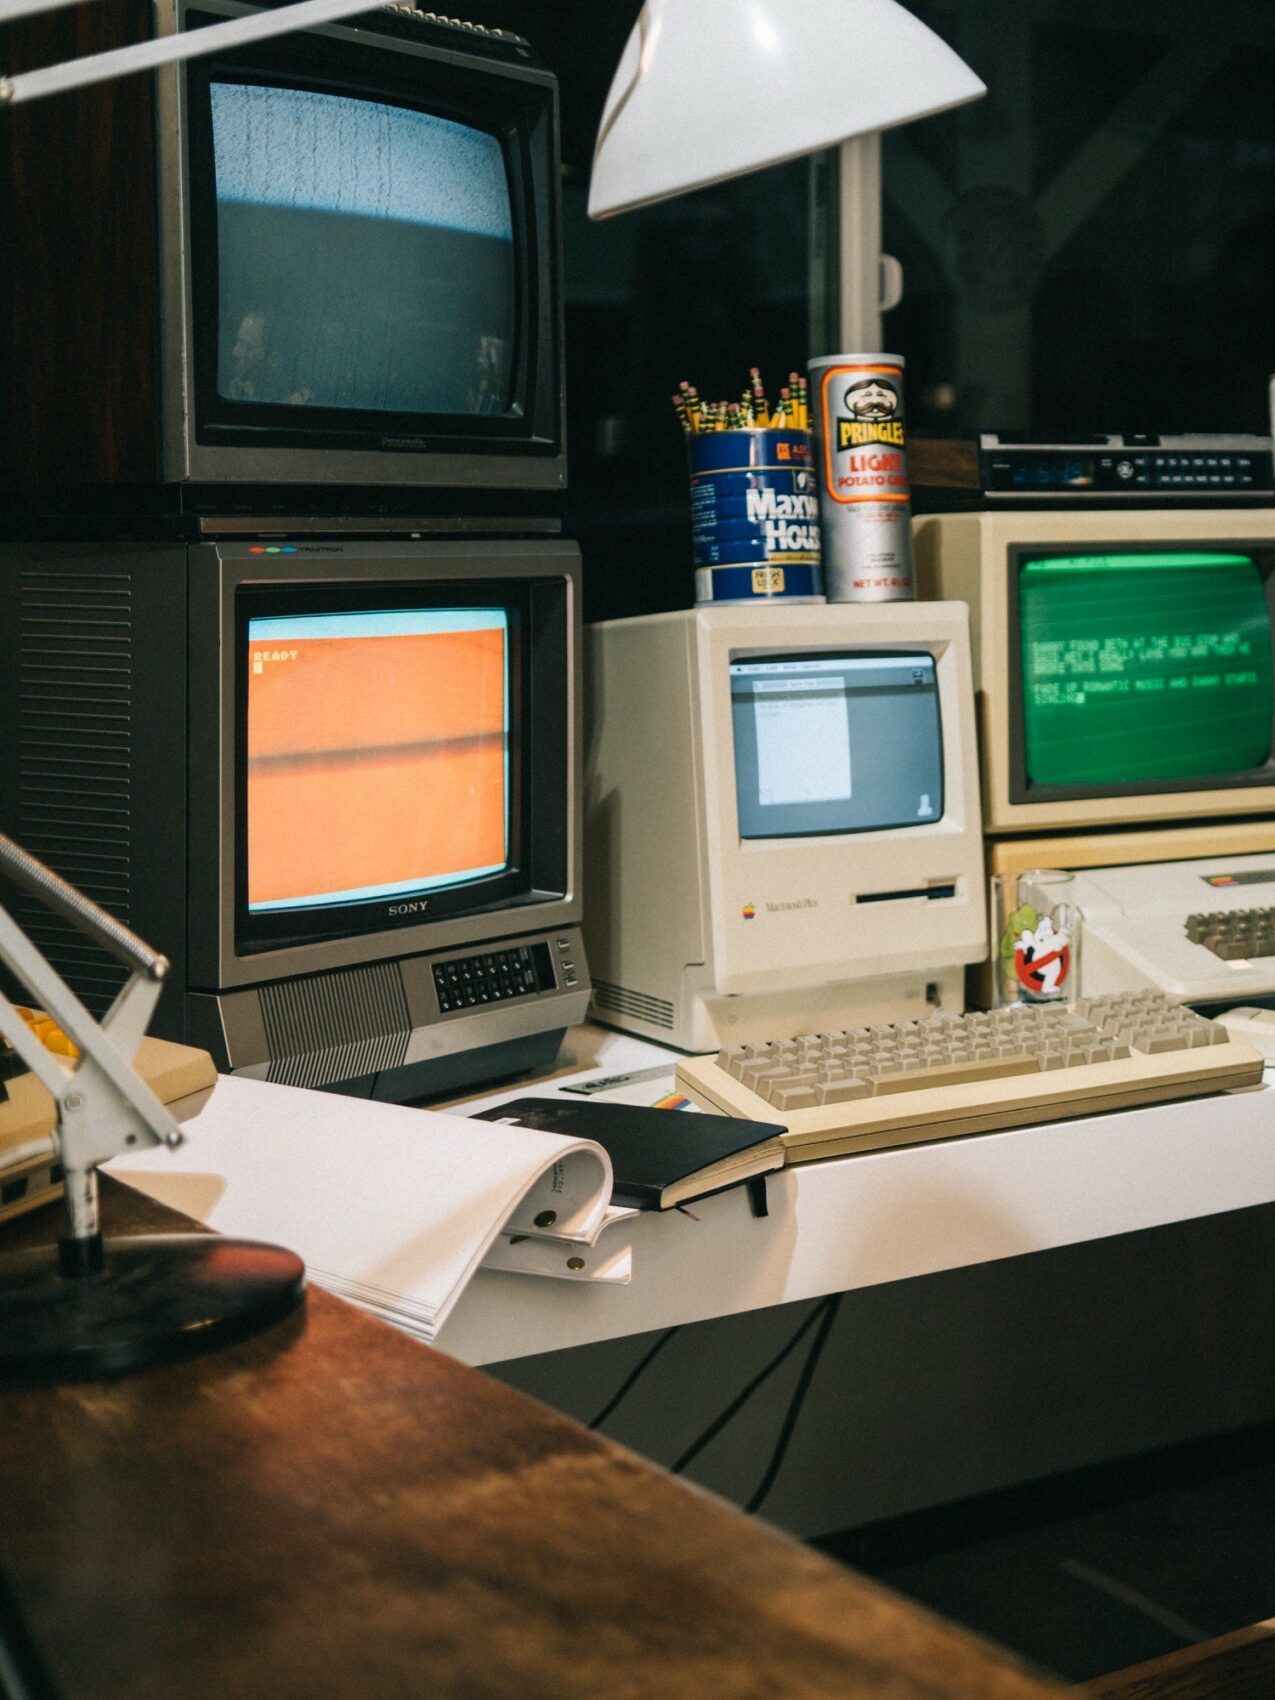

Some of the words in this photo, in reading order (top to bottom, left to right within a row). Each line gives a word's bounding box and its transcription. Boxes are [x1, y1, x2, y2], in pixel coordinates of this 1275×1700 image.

[850, 454, 901, 472] LIGHT
[253, 650, 298, 661] READY
[388, 900, 428, 917] SONY
